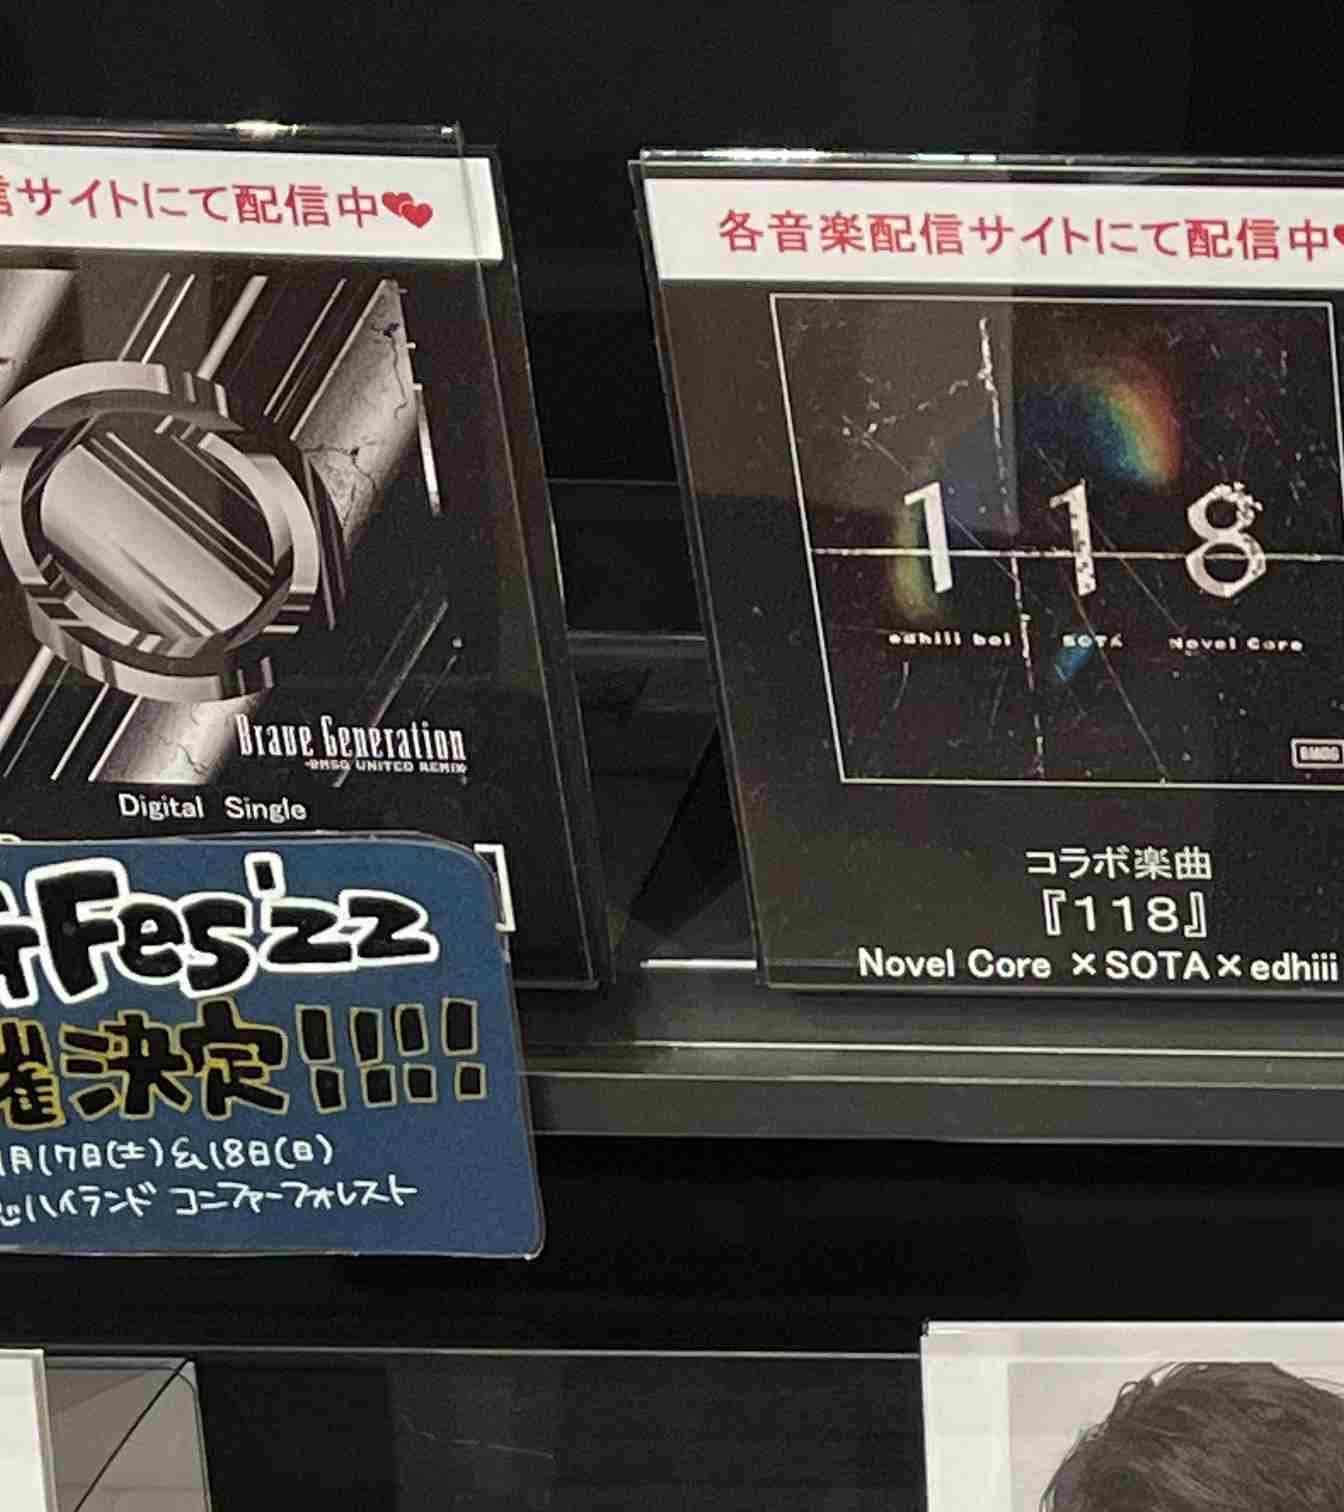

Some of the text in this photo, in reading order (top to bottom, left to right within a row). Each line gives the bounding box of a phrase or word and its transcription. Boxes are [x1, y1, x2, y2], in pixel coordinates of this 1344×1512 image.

[719, 210, 1330, 262] 各音楽配信サイトにて配信中
[320, 715, 466, 760] Generation
[118, 793, 307, 823] Digital Single
[1026, 846, 1213, 881] コラボ楽曲
[857, 947, 954, 977] Novel
[968, 949, 1052, 979] Core
